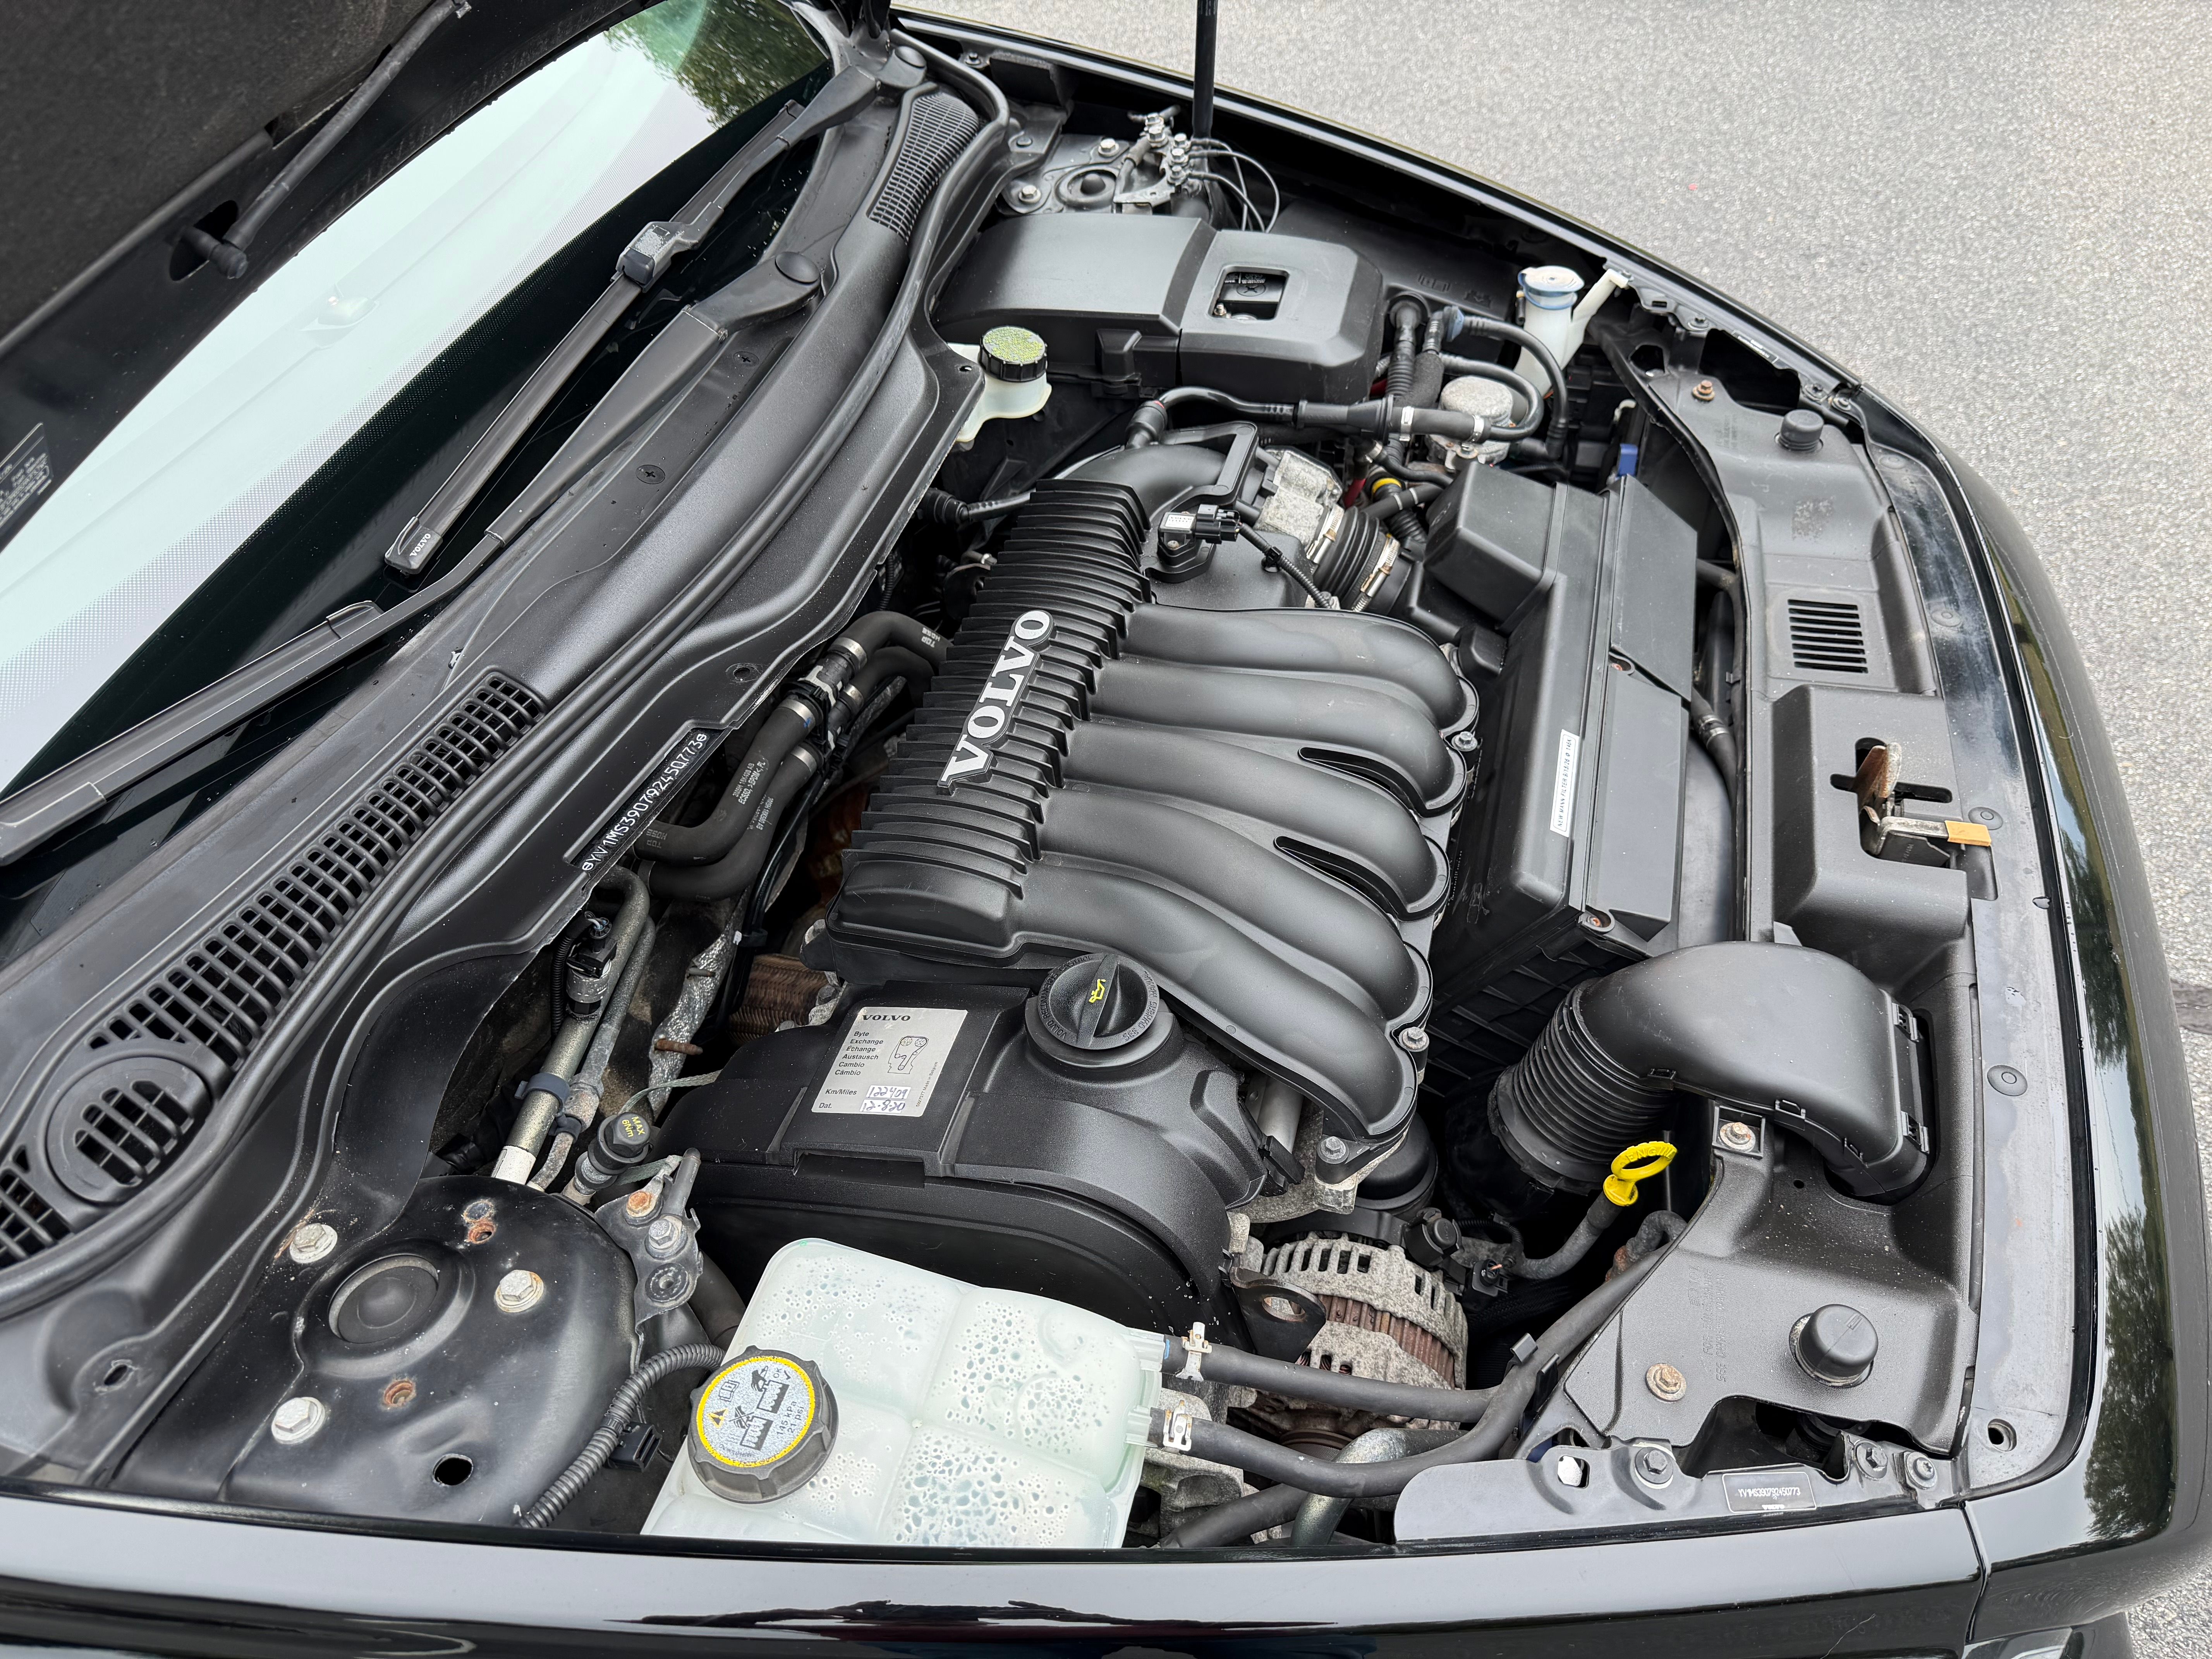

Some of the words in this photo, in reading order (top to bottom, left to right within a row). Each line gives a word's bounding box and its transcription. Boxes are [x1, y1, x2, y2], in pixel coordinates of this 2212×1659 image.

[410, 533, 431, 556] VOLVO
[941, 611, 1050, 782] VOLVO
[646, 829, 667, 840] HOSE
[647, 840, 661, 848] TOP
[1047, 1020, 1067, 1039] VOLVO
[1123, 1028, 1139, 1041] SEE
[1138, 1001, 1157, 1029] OWNERS
[622, 1120, 634, 1137] 6Nm
[631, 1116, 646, 1135] MAX
[773, 1367, 783, 1379] OK
[1716, 1362, 1726, 1382] SEE
[777, 1420, 788, 1435] 145
[786, 1401, 797, 1418] kPa
[787, 1423, 798, 1434] 21
[795, 1406, 805, 1421] psi
